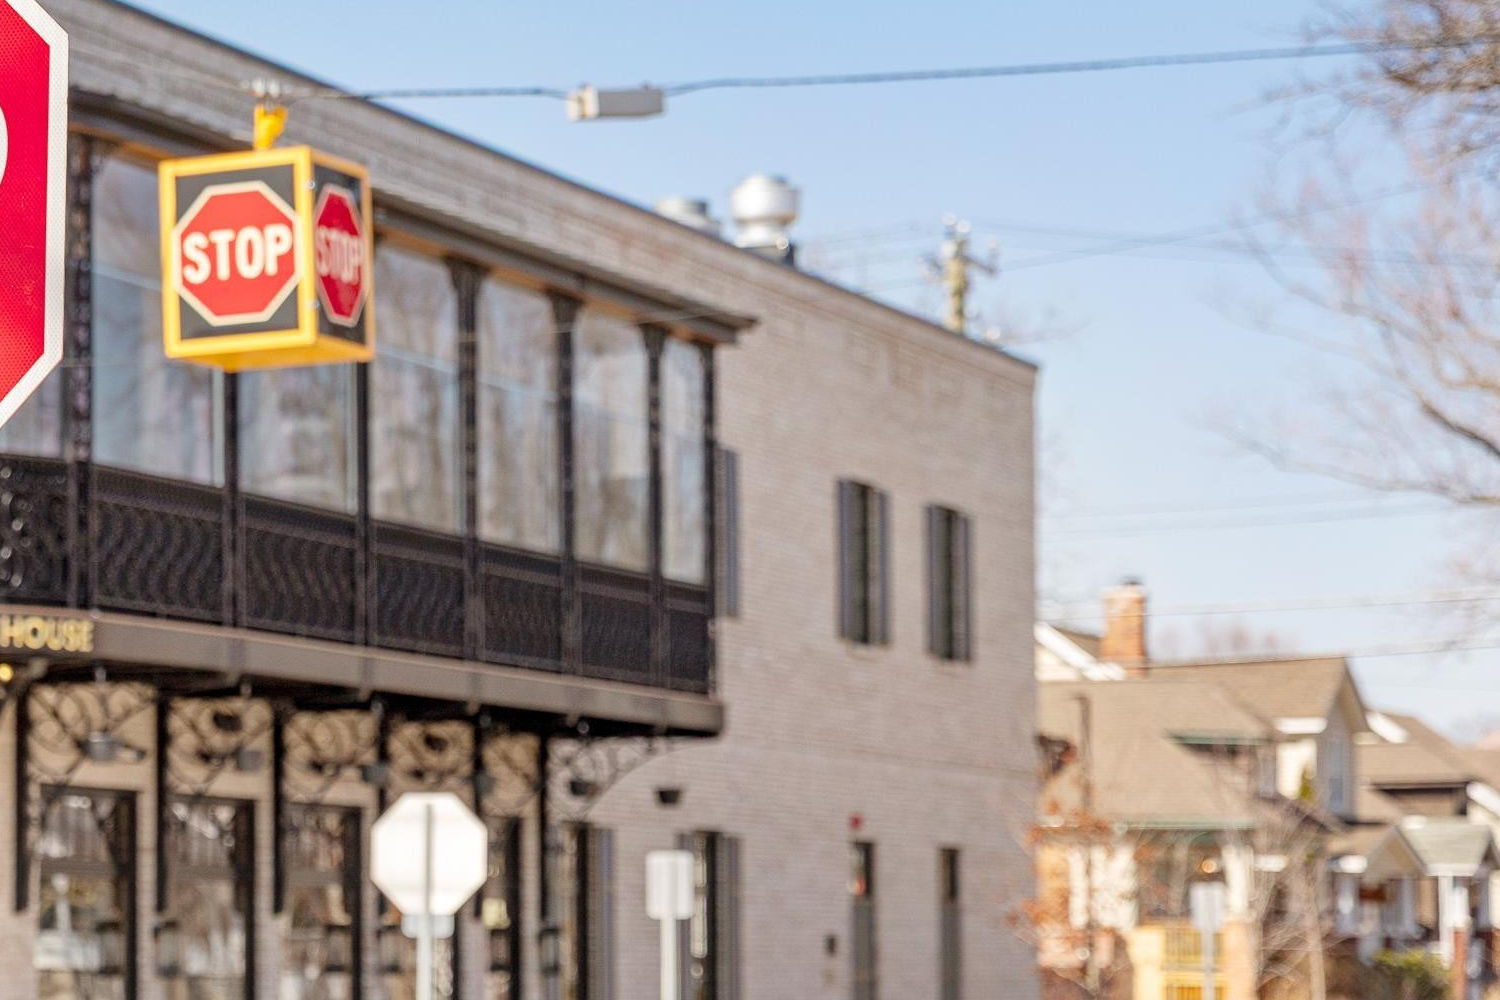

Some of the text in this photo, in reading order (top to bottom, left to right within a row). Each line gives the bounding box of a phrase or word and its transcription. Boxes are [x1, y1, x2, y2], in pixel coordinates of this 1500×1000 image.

[182, 223, 293, 284] STOP
[316, 225, 362, 284] STOP
[0, 615, 94, 653] HOUSE
